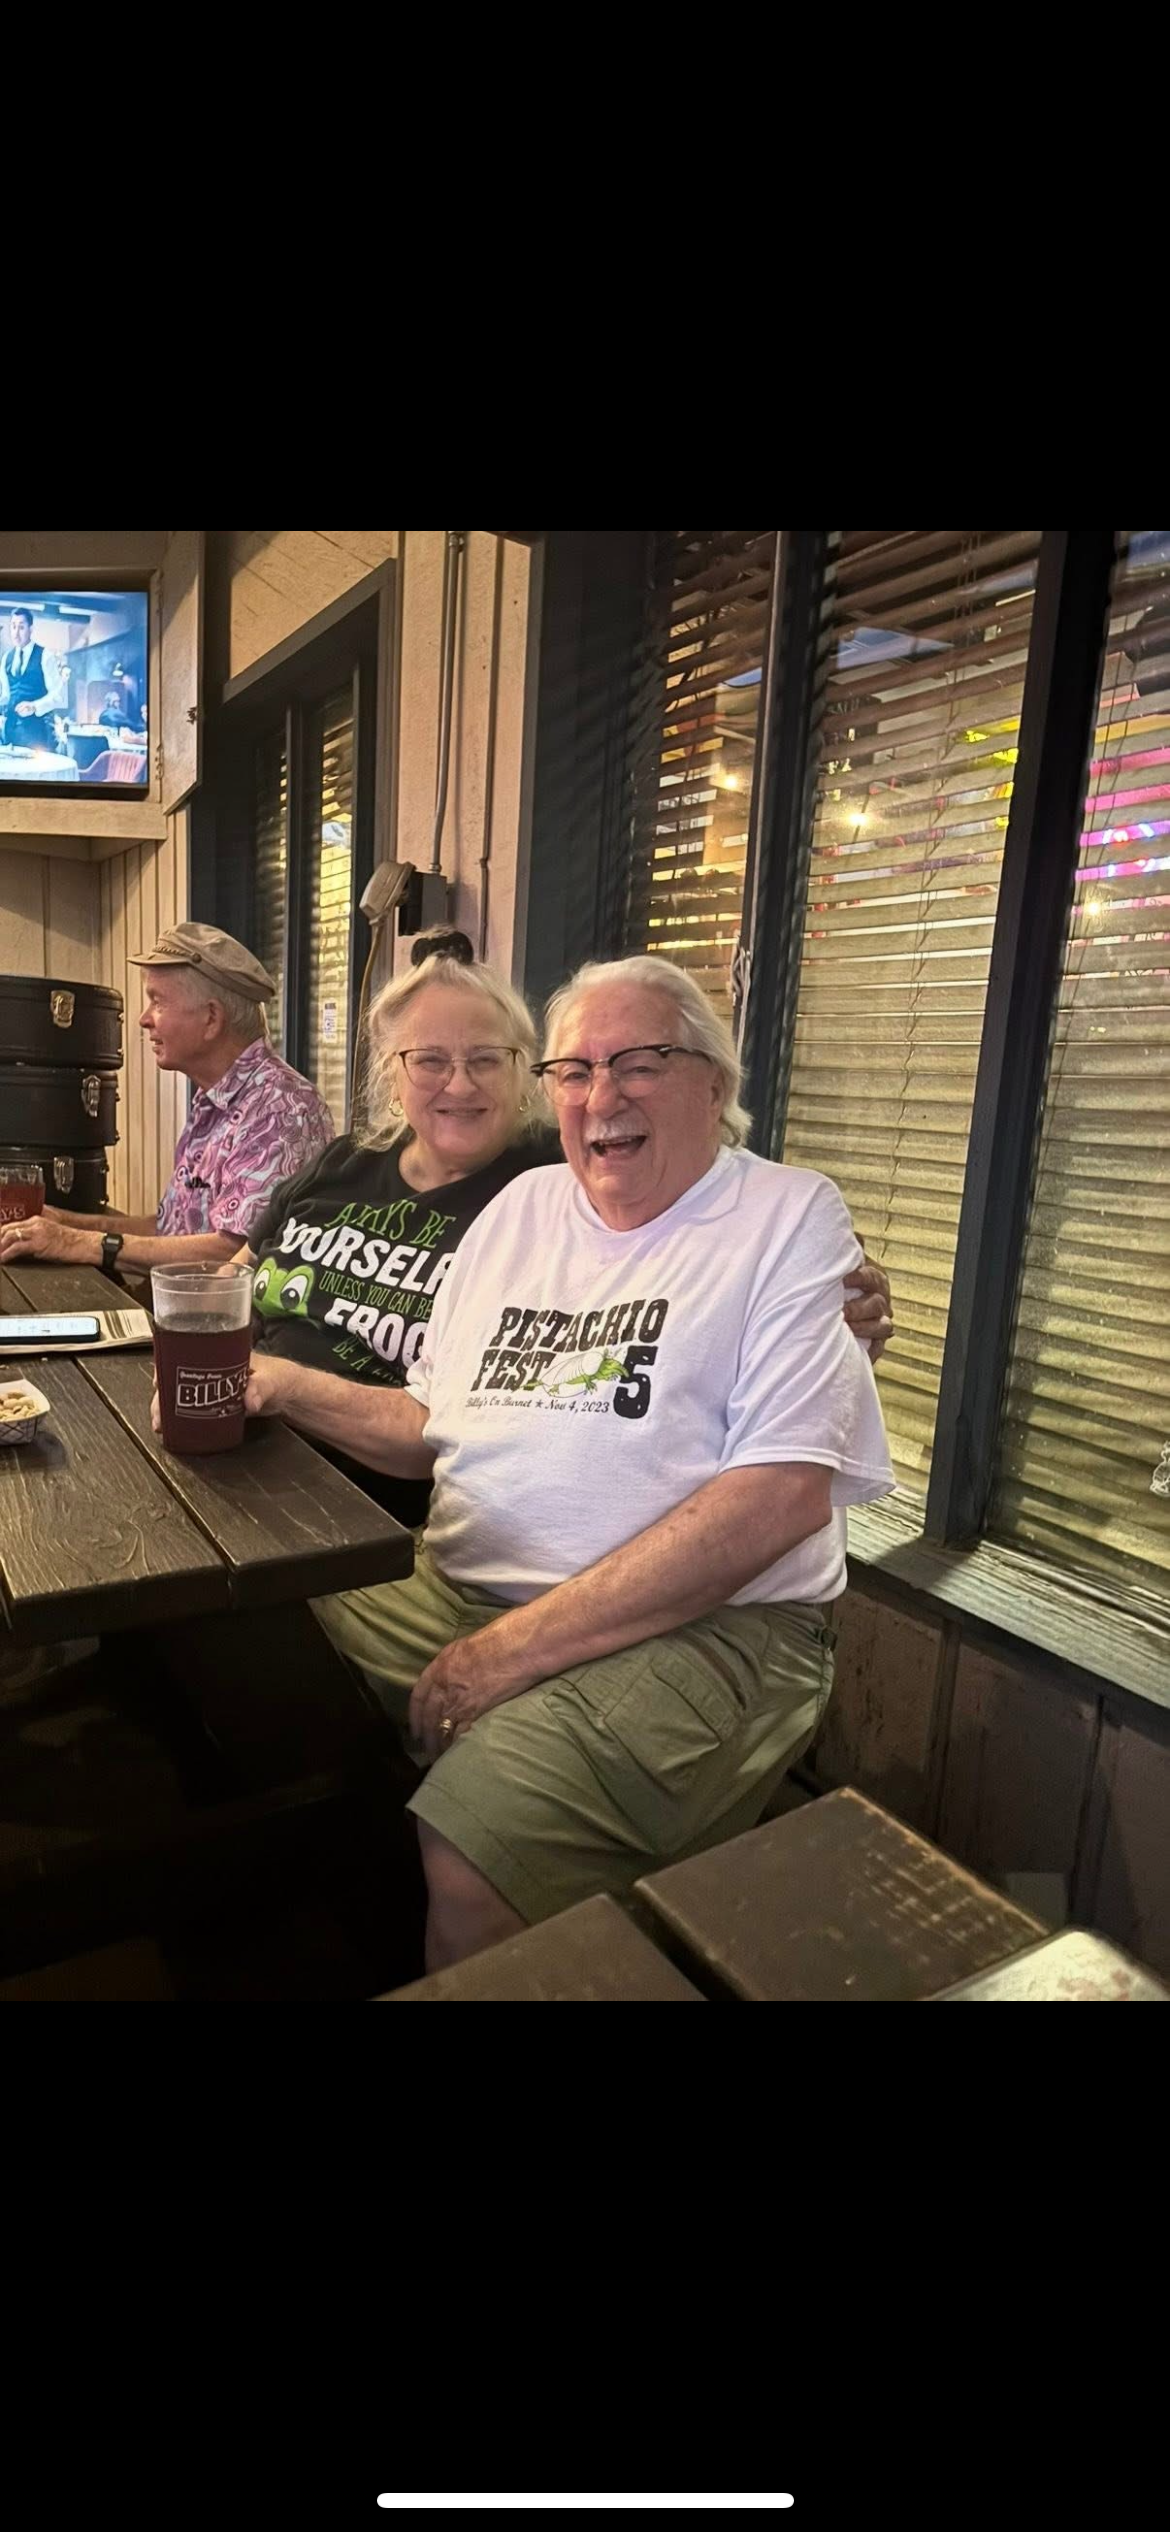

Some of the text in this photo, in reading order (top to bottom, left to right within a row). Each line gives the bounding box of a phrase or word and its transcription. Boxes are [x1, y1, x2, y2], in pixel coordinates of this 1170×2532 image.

[324, 1199, 457, 1248] AAYS BE
[319, 1270, 434, 1320] UNLESS YOU CAN BE
[488, 1298, 669, 1352] PISTACHIO
[470, 1345, 659, 1419] FEST 5
[501, 1395, 532, 1408] Burnet
[545, 1399, 566, 1411] Nov
[568, 1400, 578, 1414] 4,
[580, 1401, 610, 1413] 2023
